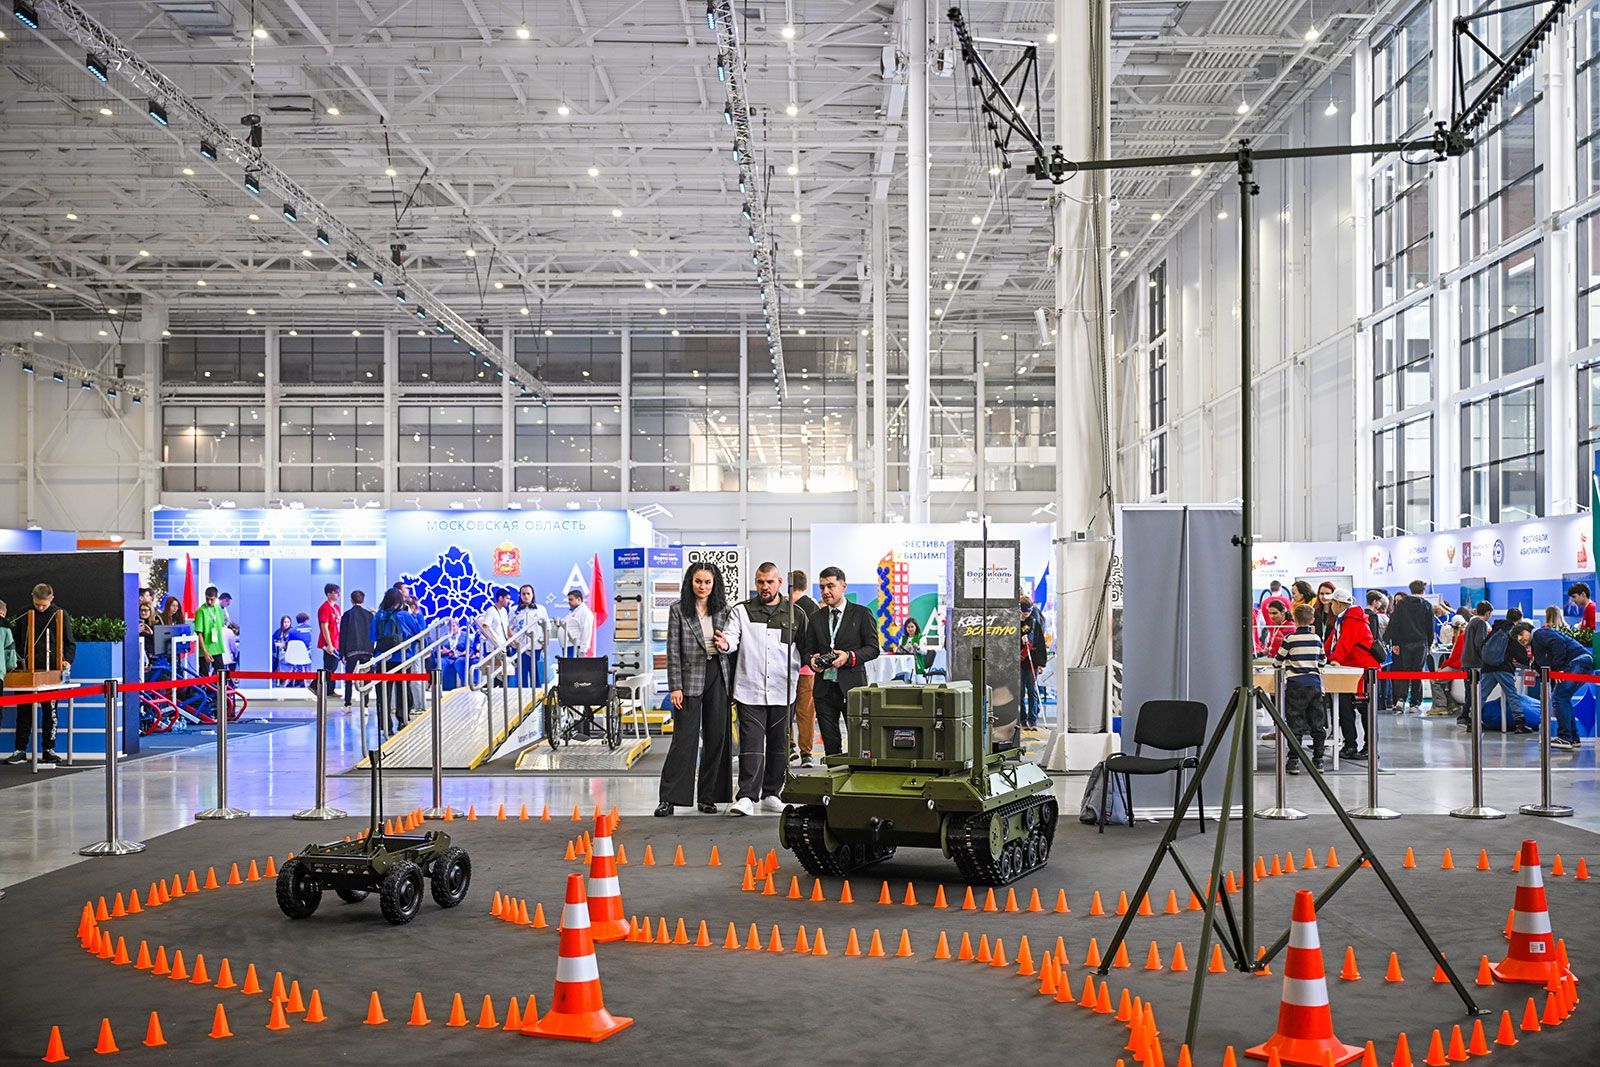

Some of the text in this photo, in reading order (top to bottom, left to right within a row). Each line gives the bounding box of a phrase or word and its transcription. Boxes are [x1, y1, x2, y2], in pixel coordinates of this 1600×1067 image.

[427, 520, 586, 531] МОСКОВСКАЯ ОБЛАСТЬ
[903, 540, 946, 548] ФЕСТИВА
[897, 552, 946, 560] БИЛИМП
[966, 570, 1012, 578] Верикаль
